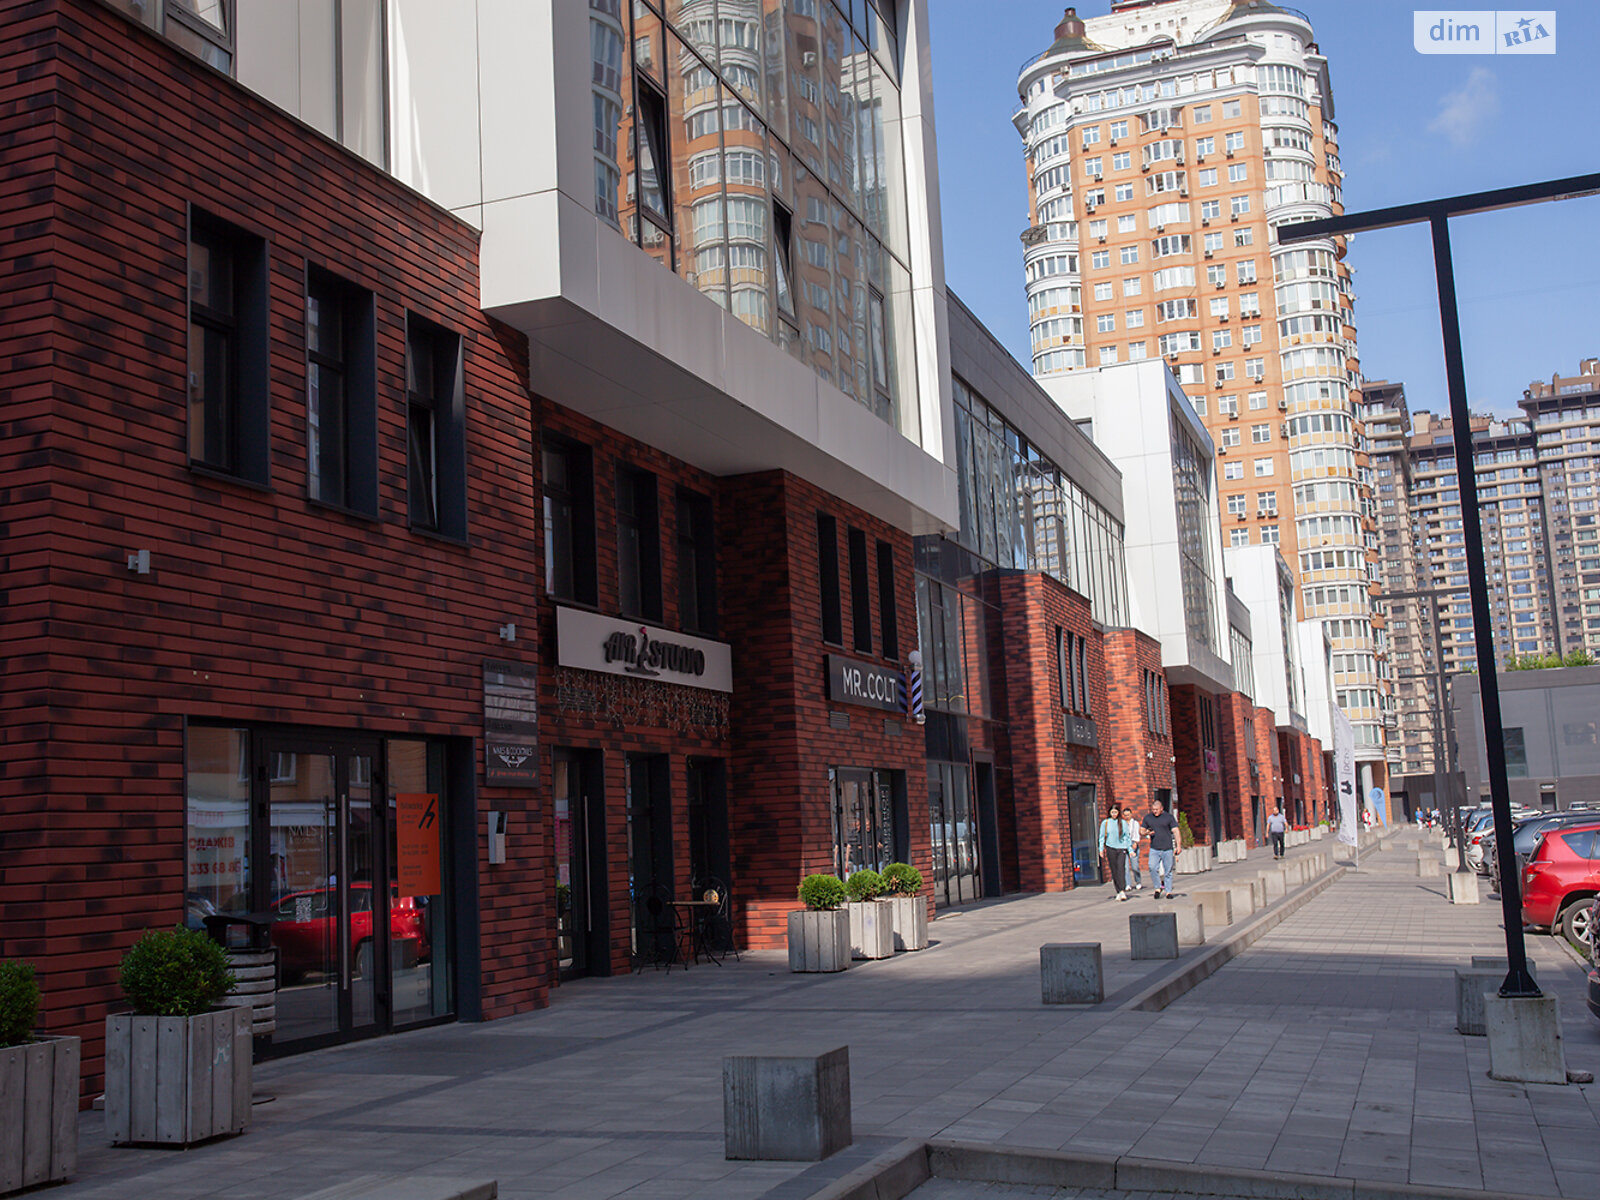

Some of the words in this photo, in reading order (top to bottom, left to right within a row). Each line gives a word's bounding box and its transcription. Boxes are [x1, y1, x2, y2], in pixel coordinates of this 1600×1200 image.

[603, 631, 637, 664] AIR
[648, 640, 705, 677] STUDIO
[842, 666, 896, 703] MR.COLT
